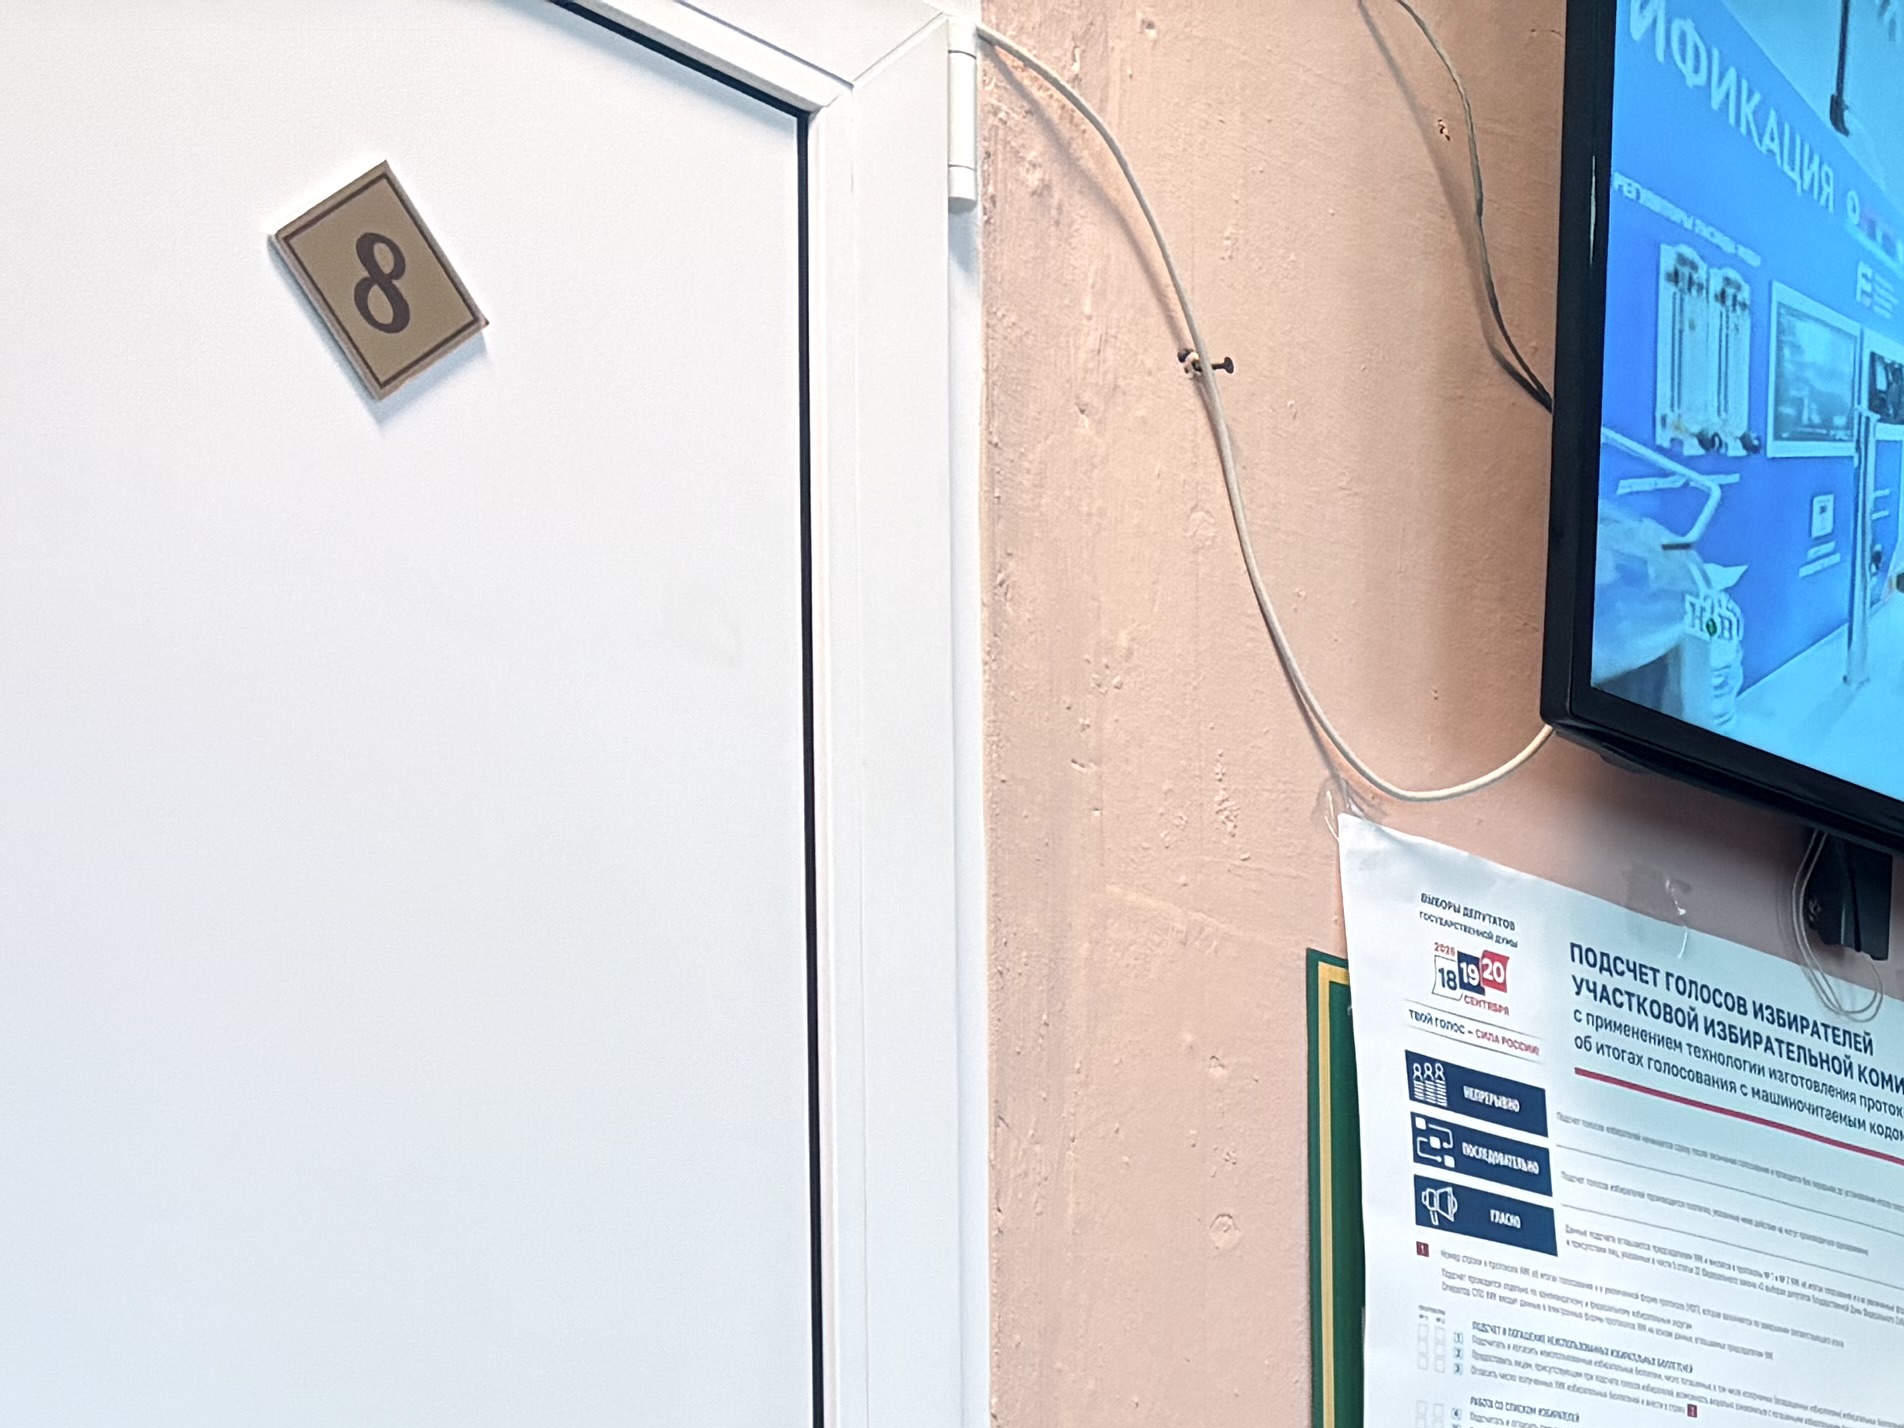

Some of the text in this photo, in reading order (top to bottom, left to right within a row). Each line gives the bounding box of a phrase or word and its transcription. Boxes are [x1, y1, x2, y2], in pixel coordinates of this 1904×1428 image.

[354, 232, 411, 334] 8
[1438, 957, 1504, 990] 18 19 20
[1570, 942, 1873, 1056] ПОДСЧЕТ ГОЛОСОВ ИЗБИРАТЕЛЕЙ
[1572, 974, 1698, 1033] УЧАСТКОВОЙ
[1705, 1018, 1853, 1078] ИЗБИРАТЕЛЬНОЙ
[1574, 1010, 1583, 1023] с
[1587, 1015, 1682, 1052] применением
[1686, 1043, 1765, 1077] технологии
[1769, 1066, 1856, 1105] изготовления
[1575, 1035, 1591, 1053] об
[1597, 1044, 1643, 1068] итогах
[1647, 1059, 1737, 1095] голосования
[1741, 1085, 1748, 1097] с
[1751, 1088, 1865, 1130] машиночитаемым
